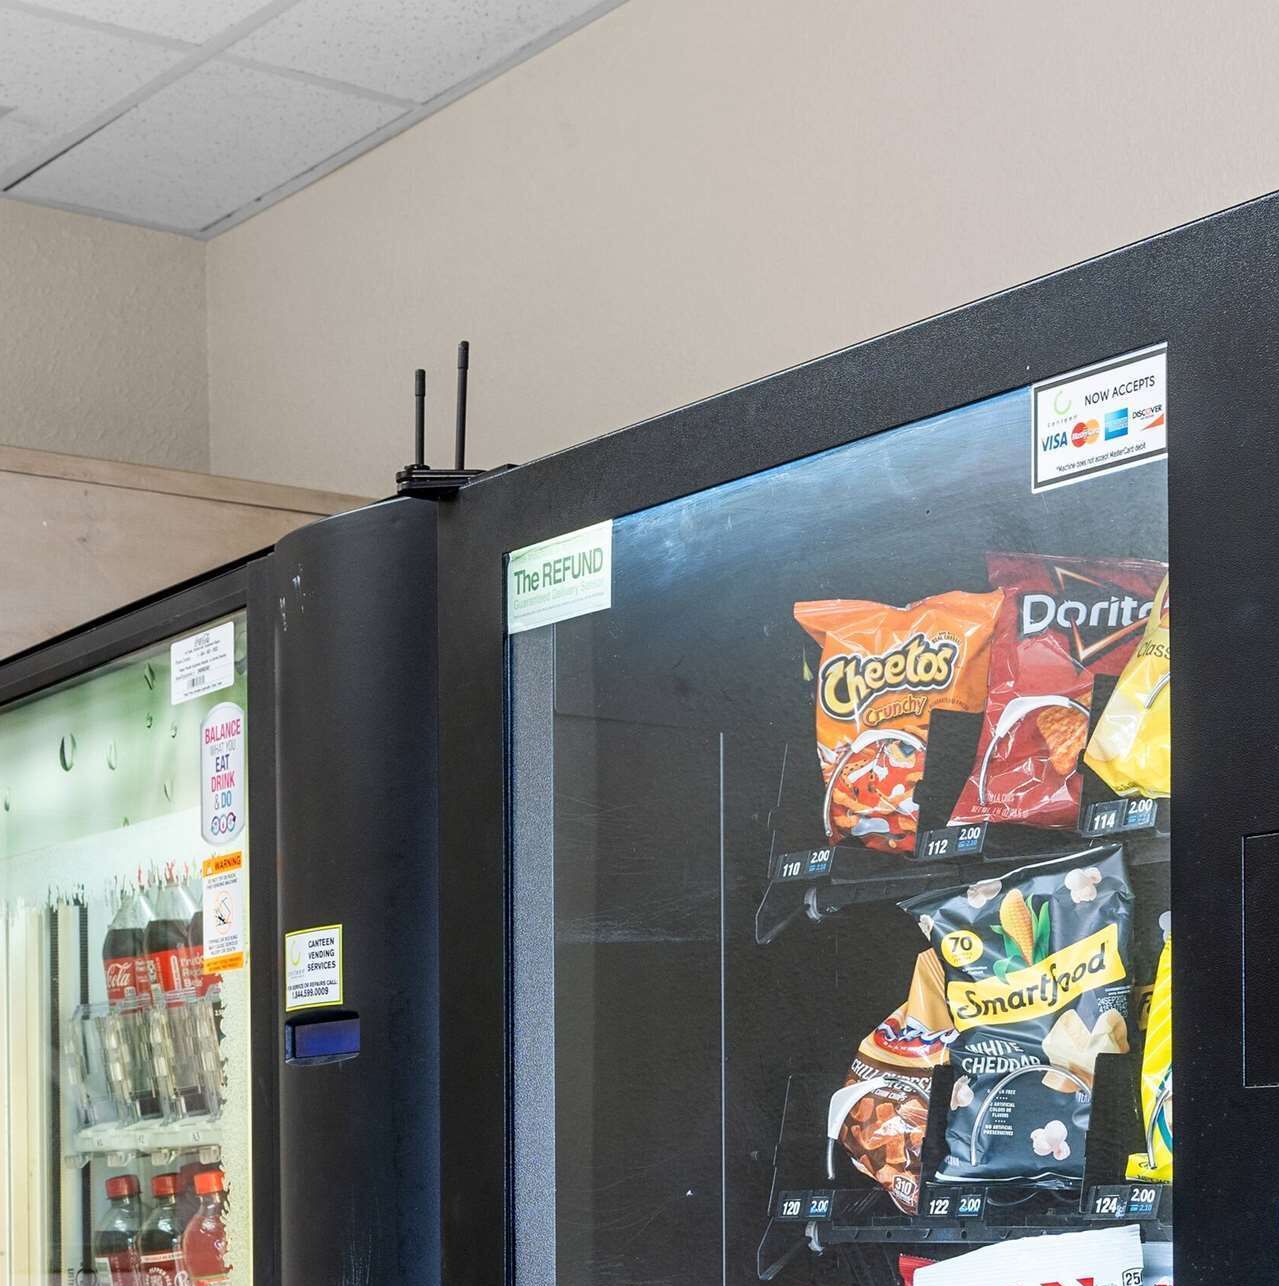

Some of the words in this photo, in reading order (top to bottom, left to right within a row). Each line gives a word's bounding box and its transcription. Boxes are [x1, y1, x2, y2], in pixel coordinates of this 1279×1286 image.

[1084, 390, 1109, 406] NOW
[1112, 375, 1155, 398] ACCEPTS
[1132, 404, 1162, 419] DISCOVER
[1041, 432, 1068, 452] VISA
[514, 570, 539, 595] The
[542, 548, 603, 587] REFUND
[1022, 593, 1169, 635] Dorit
[821, 634, 958, 720] Cheetos
[863, 695, 927, 728] Crunchy
[204, 719, 241, 745] BALANCE
[215, 754, 229, 773] EAT
[211, 771, 235, 793] DRINK
[221, 791, 232, 807] DO
[1094, 812, 1116, 830] 114
[1128, 799, 1152, 814] 2.00
[928, 840, 948, 855] 112
[959, 827, 980, 840] 2.00
[215, 855, 240, 871] WARNING
[783, 862, 800, 877] 110
[811, 850, 830, 862] 2.00
[308, 938, 334, 948] CANTEEN
[950, 936, 972, 953] 70
[308, 949, 335, 959] VENDING
[308, 961, 336, 971] SERVICES
[957, 942, 1106, 1019] Smartfood
[965, 1040, 1024, 1056] WHITE
[895, 1177, 912, 1193] 310
[783, 1201, 800, 1215] 120
[929, 1200, 948, 1215] 122
[959, 1199, 980, 1212] 2.00
[1096, 1198, 1117, 1213] 124
[1131, 1189, 1155, 1202] 2.00
